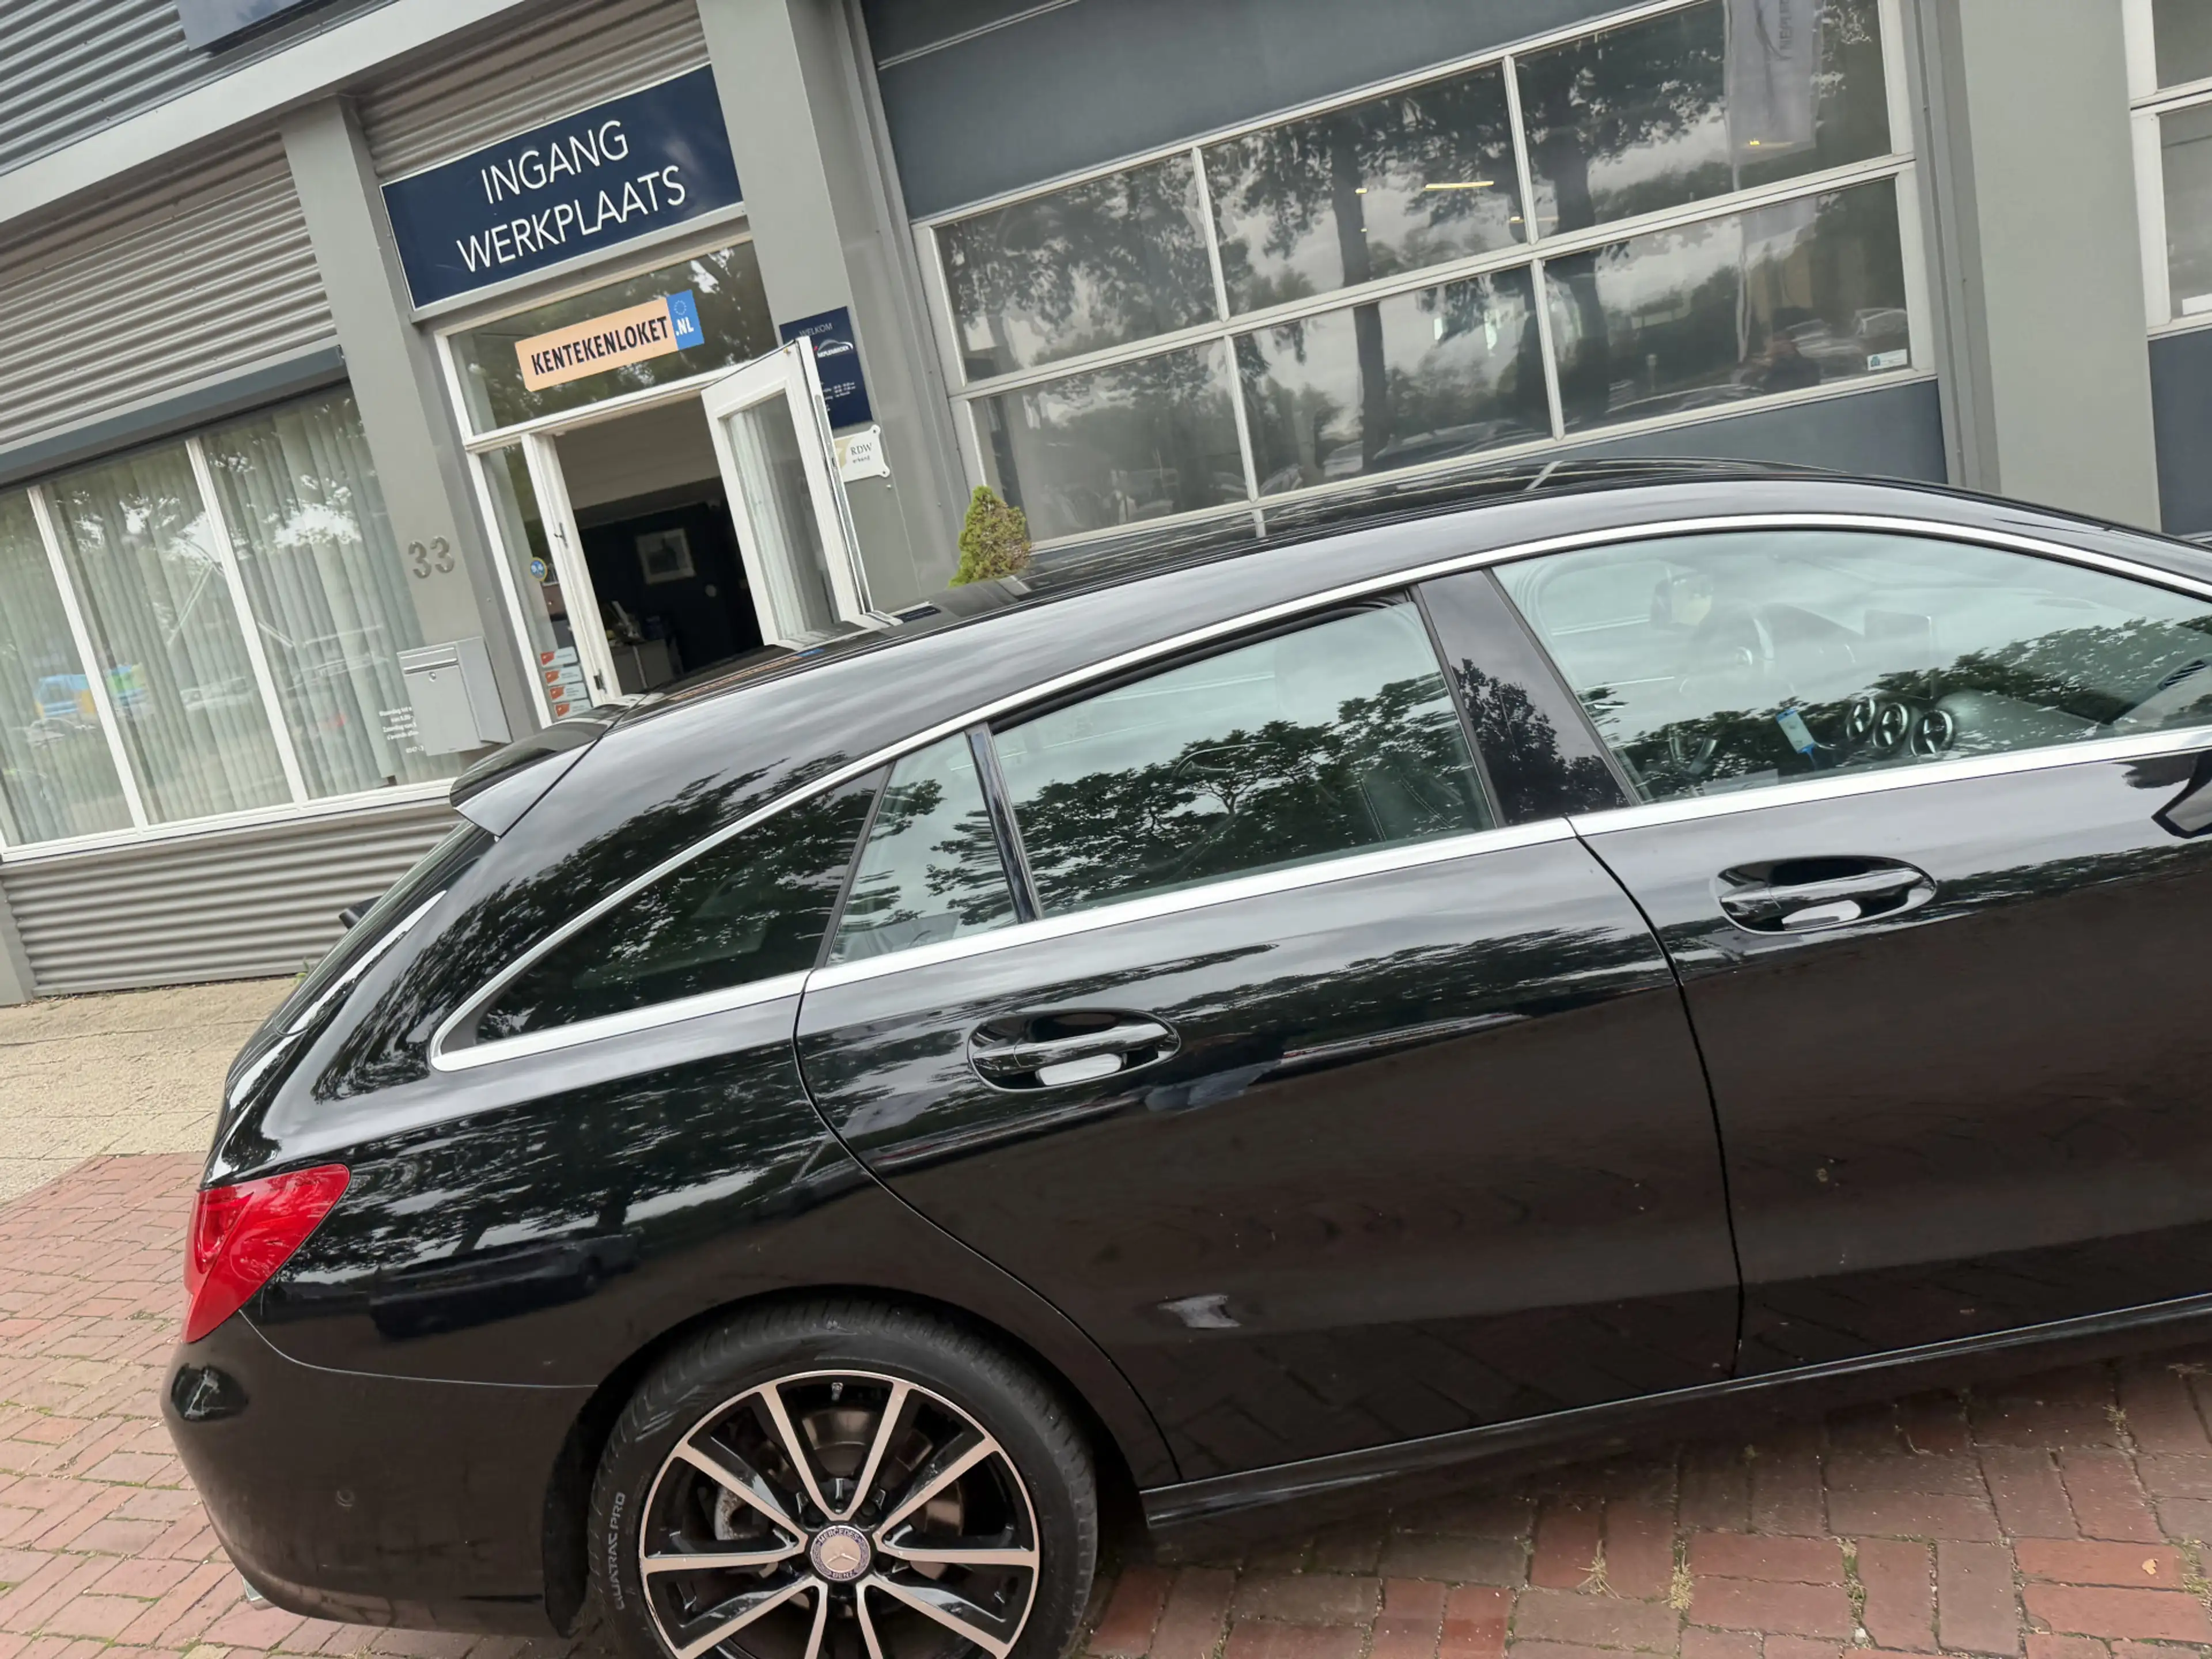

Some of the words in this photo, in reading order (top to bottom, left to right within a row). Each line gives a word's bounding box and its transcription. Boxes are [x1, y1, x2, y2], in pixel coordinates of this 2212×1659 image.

[480, 120, 629, 204] INGANG
[456, 165, 686, 273] WERKPLAATS
[531, 315, 669, 375] KENTEKENLOKET
[675, 318, 695, 337] .NL
[799, 323, 833, 336] WELKOM
[850, 442, 872, 455] RDW
[408, 536, 454, 579] 33
[610, 1491, 626, 1530] PRO
[819, 1528, 860, 1544] MERCEDES
[608, 1532, 626, 1611] QUATRAC
